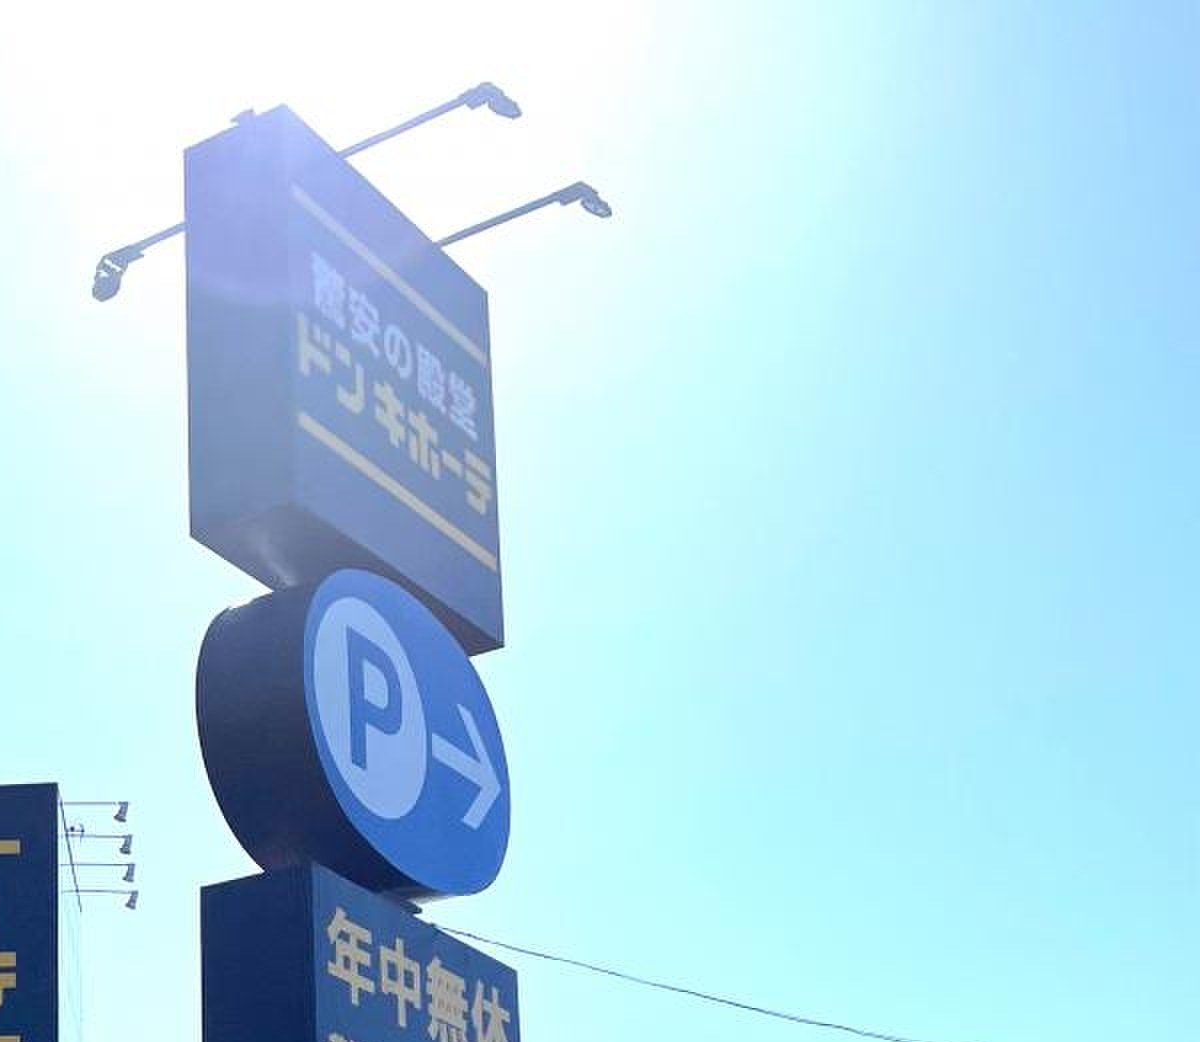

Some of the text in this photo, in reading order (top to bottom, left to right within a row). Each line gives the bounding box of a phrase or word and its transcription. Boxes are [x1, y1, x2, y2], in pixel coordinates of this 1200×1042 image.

[311, 250, 480, 442] 驚安の殿堂
[345, 622, 402, 771] P
